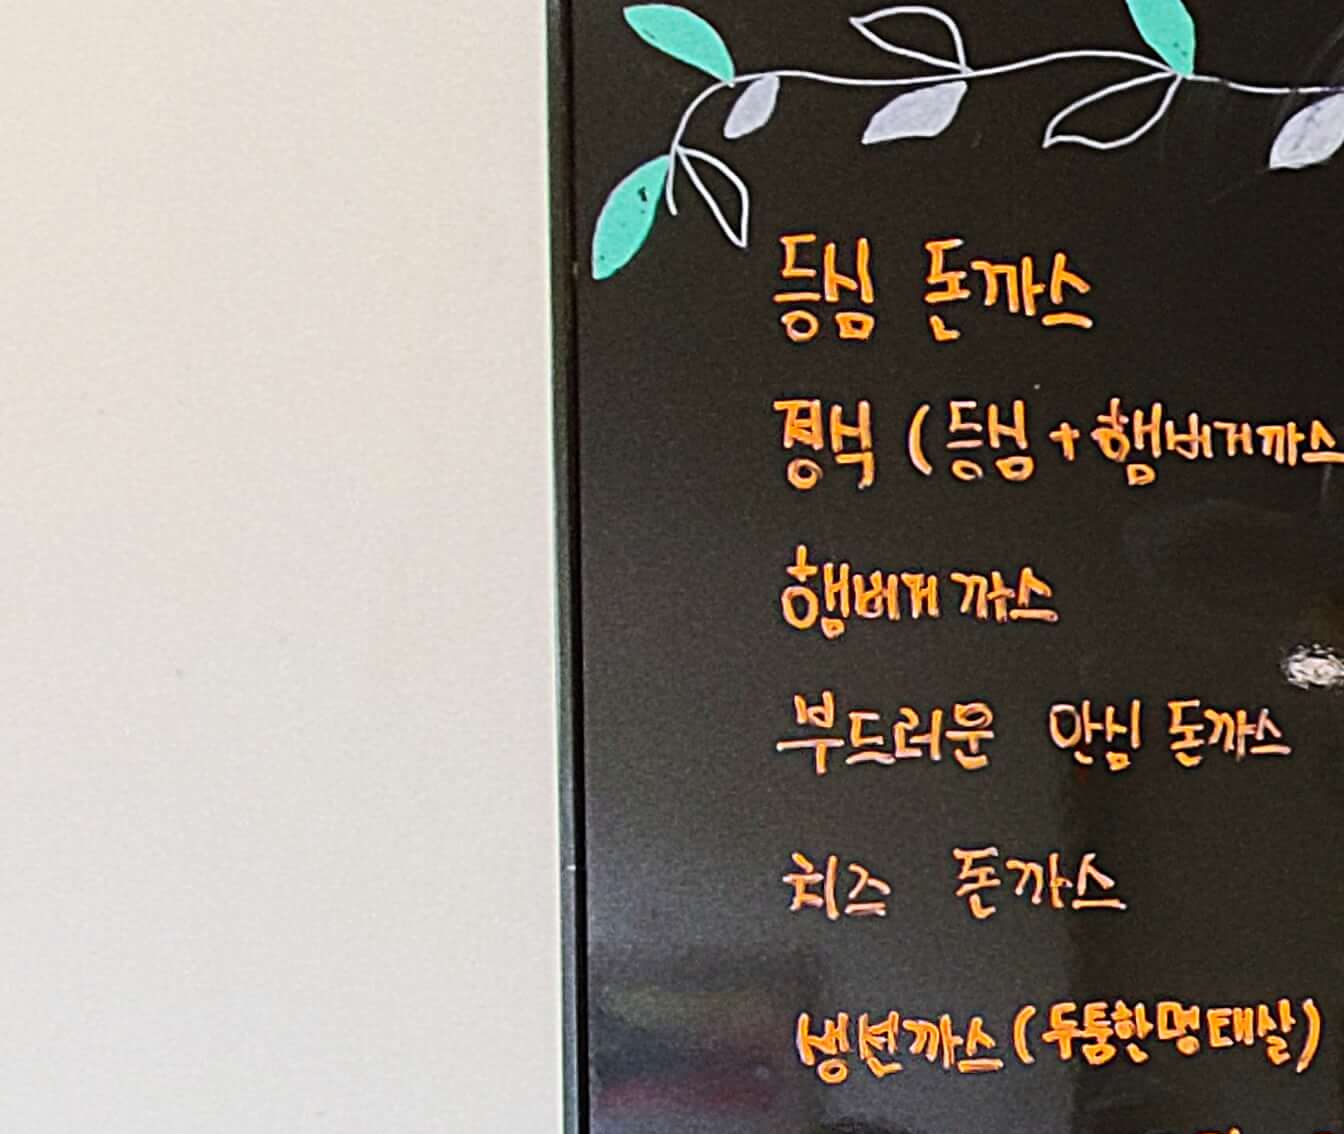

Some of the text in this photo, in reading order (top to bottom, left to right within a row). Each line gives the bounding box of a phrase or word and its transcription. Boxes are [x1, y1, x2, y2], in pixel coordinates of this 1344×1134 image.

[772, 232, 876, 343] 등심
[923, 237, 1094, 343] 돈까스
[774, 689, 996, 776] 부드러운
[1048, 698, 1142, 772] 안심
[1166, 698, 1292, 768] 돈까스
[781, 851, 892, 922] 치즈
[951, 845, 1128, 920] 돈까스
